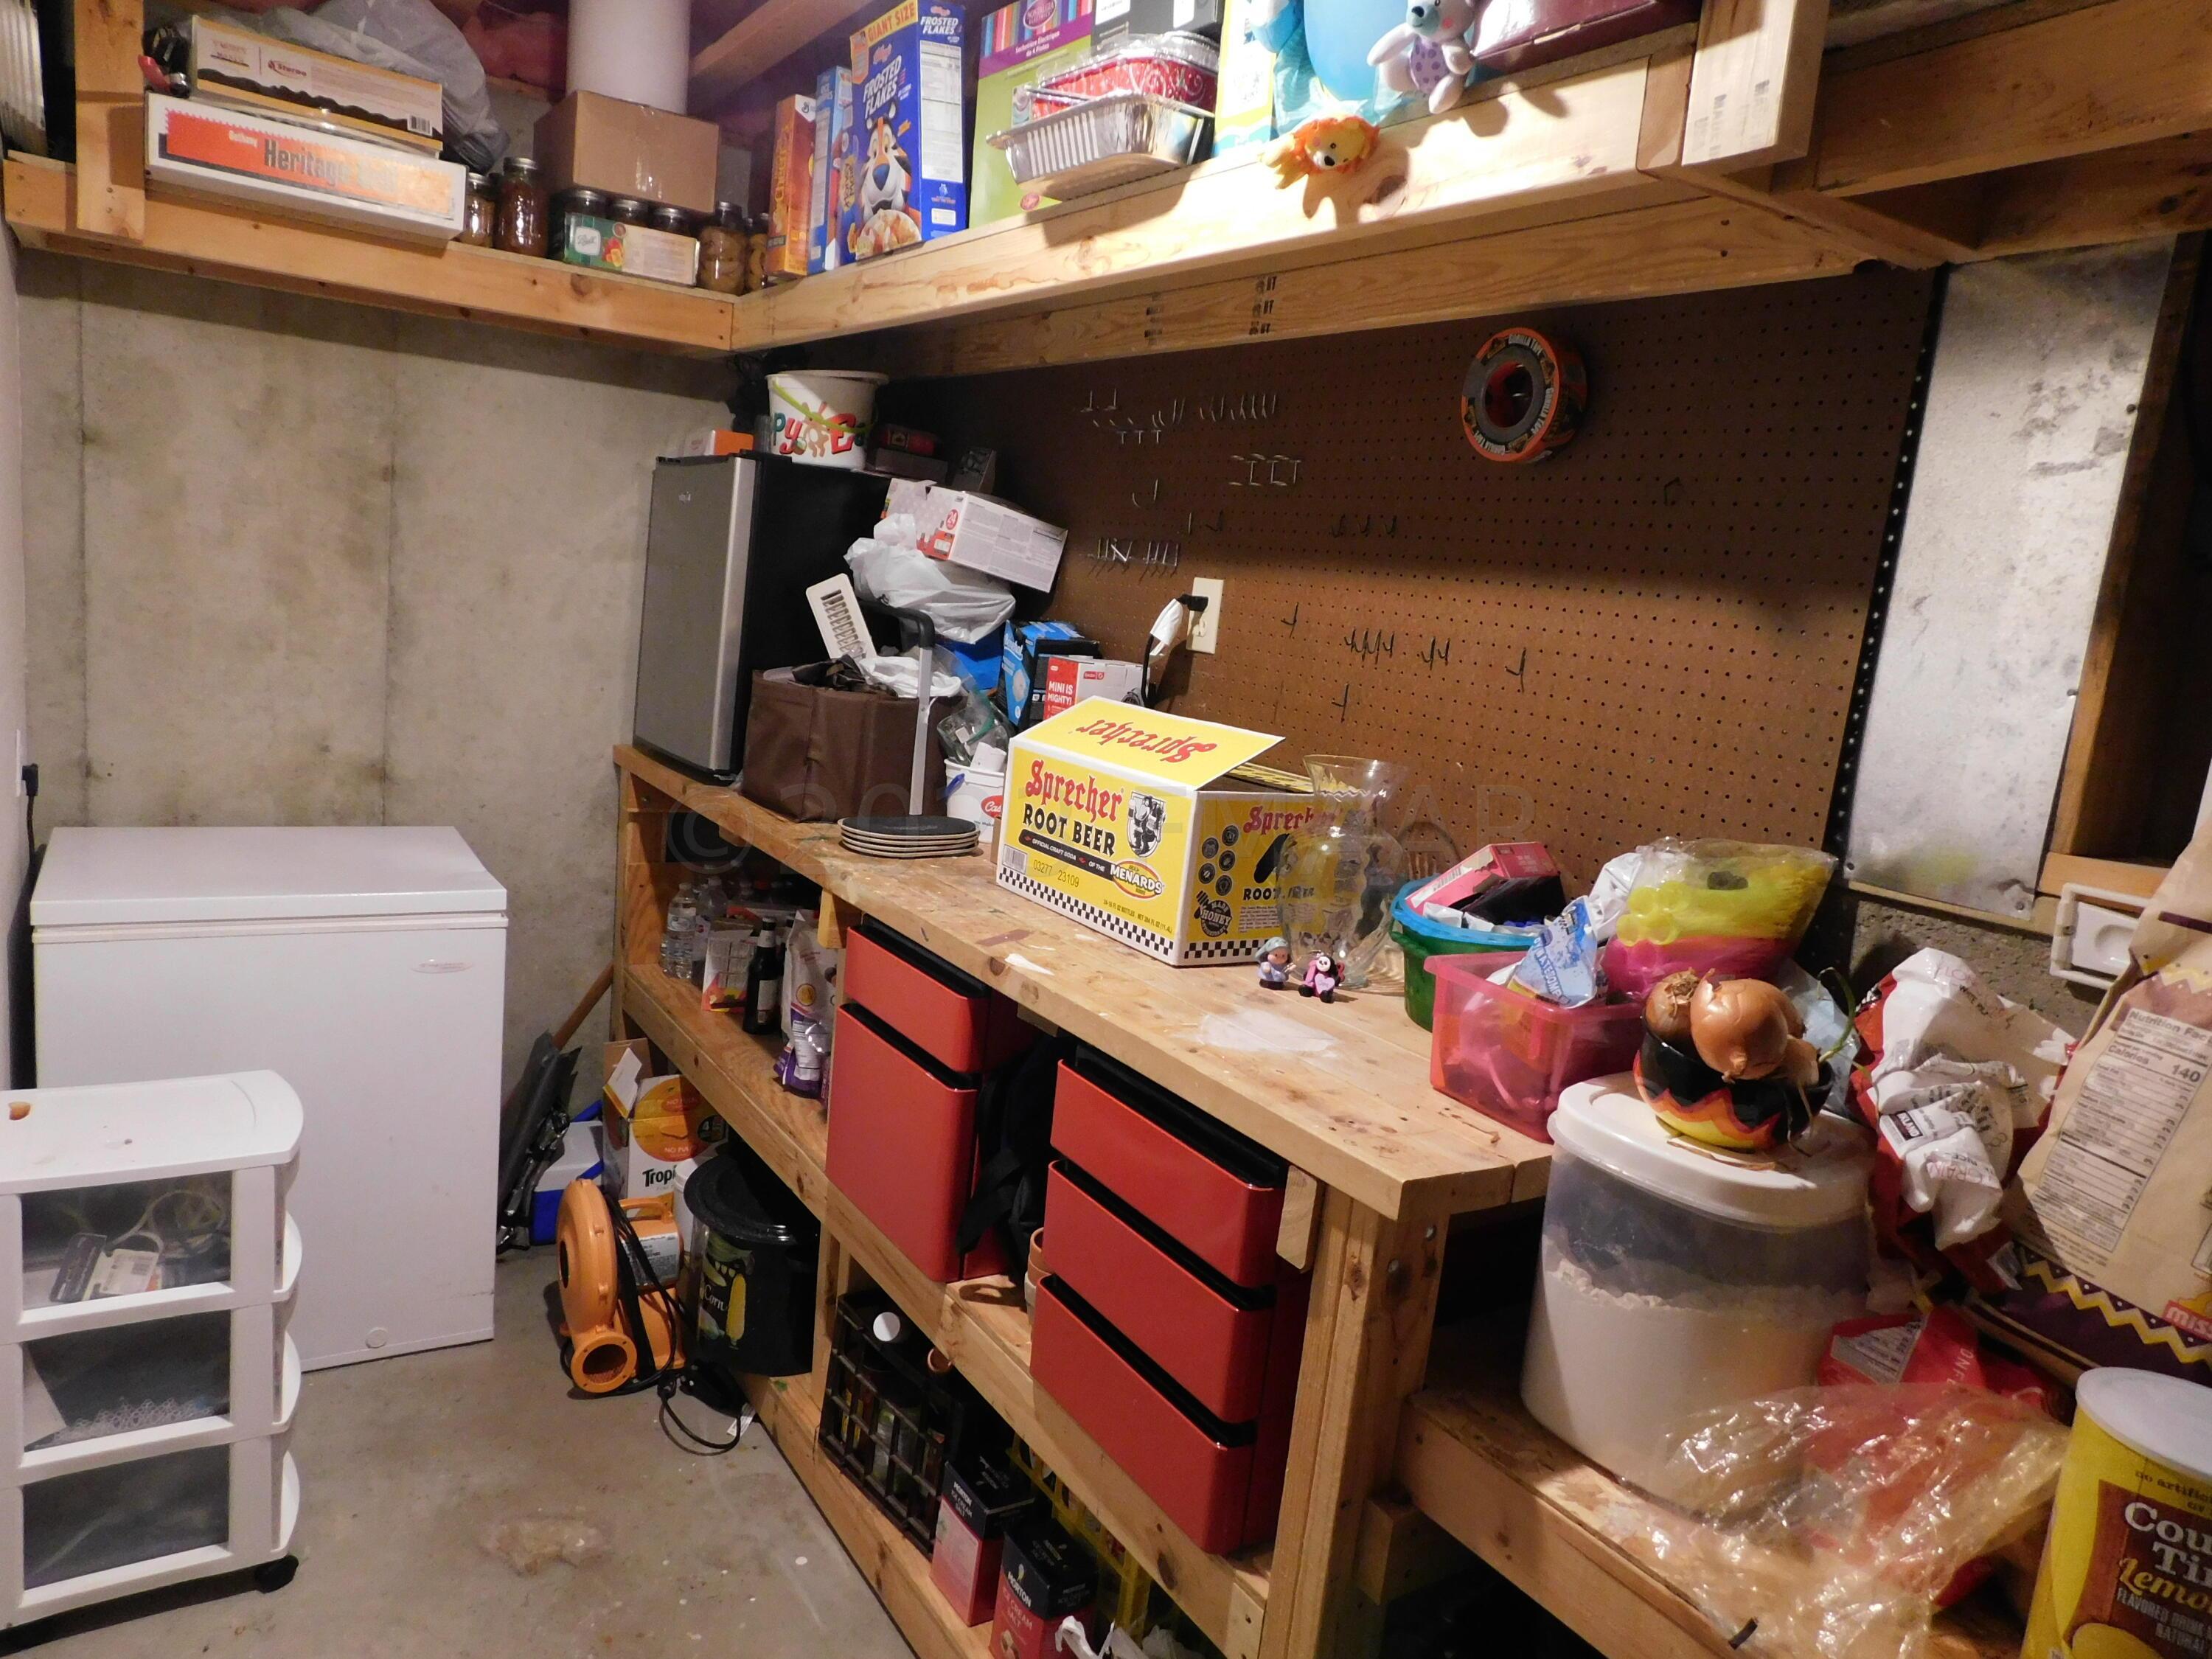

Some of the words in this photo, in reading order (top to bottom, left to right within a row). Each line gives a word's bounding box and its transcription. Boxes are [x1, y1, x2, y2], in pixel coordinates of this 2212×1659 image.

[868, 17, 893, 42] GIANT
[894, 2, 915, 27] SIZE
[920, 16, 959, 27] FROSTED
[922, 25, 956, 35] FLAKES
[863, 55, 902, 103] FROSTED
[864, 77, 898, 119] FLAKES
[263, 138, 351, 187] Heritage
[1047, 692, 1073, 706] MIGHTY!
[1048, 681, 1065, 693] MINI
[1065, 683, 1074, 695] IS
[1076, 719, 1217, 763] Sprecher
[1025, 759, 1123, 823] Sprecher
[1022, 803, 1068, 839] ROOT
[1072, 820, 1116, 857] BEER
[1032, 838, 1050, 852] OFFICIAL
[1050, 844, 1063, 856] CRAFT
[1063, 850, 1077, 861] SODA
[1096, 863, 1105, 872] THE
[1033, 859, 1053, 876] 03277
[1057, 870, 1079, 888] 23109
[1110, 863, 1163, 895] MENARDS
[1201, 908, 1233, 926] HONEY
[2129, 1010, 2181, 1033] Nutrition
[2107, 1044, 2149, 1065] Calories
[2171, 1063, 2202, 1084] 140
[1007, 1571, 1032, 1609] MORTON
